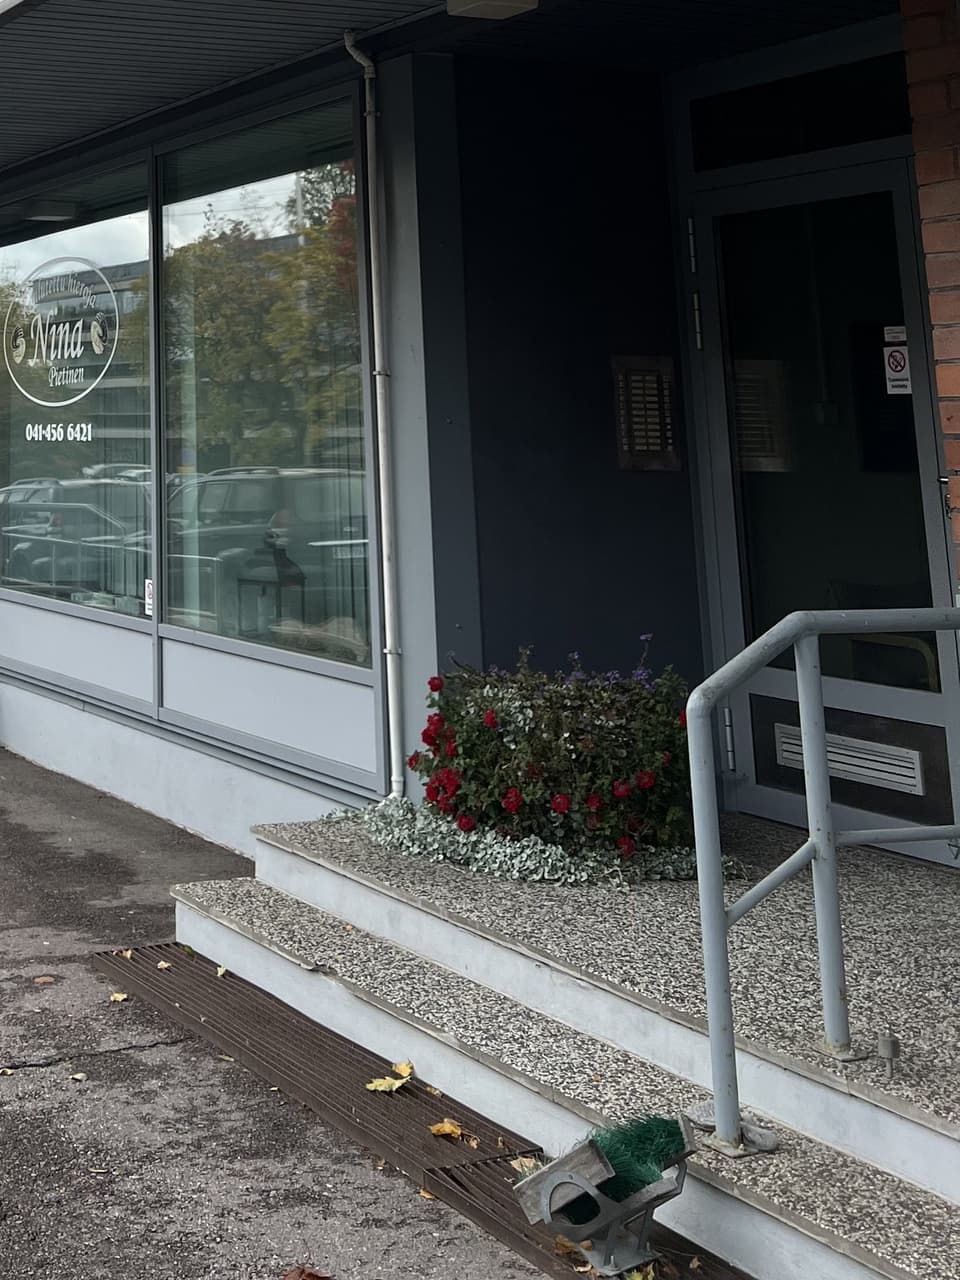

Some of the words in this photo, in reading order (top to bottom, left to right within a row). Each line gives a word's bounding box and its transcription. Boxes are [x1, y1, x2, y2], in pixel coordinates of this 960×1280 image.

[30, 308, 85, 367] Nina
[48, 365, 85, 388] Pietinen
[66, 423, 92, 442] 6421
